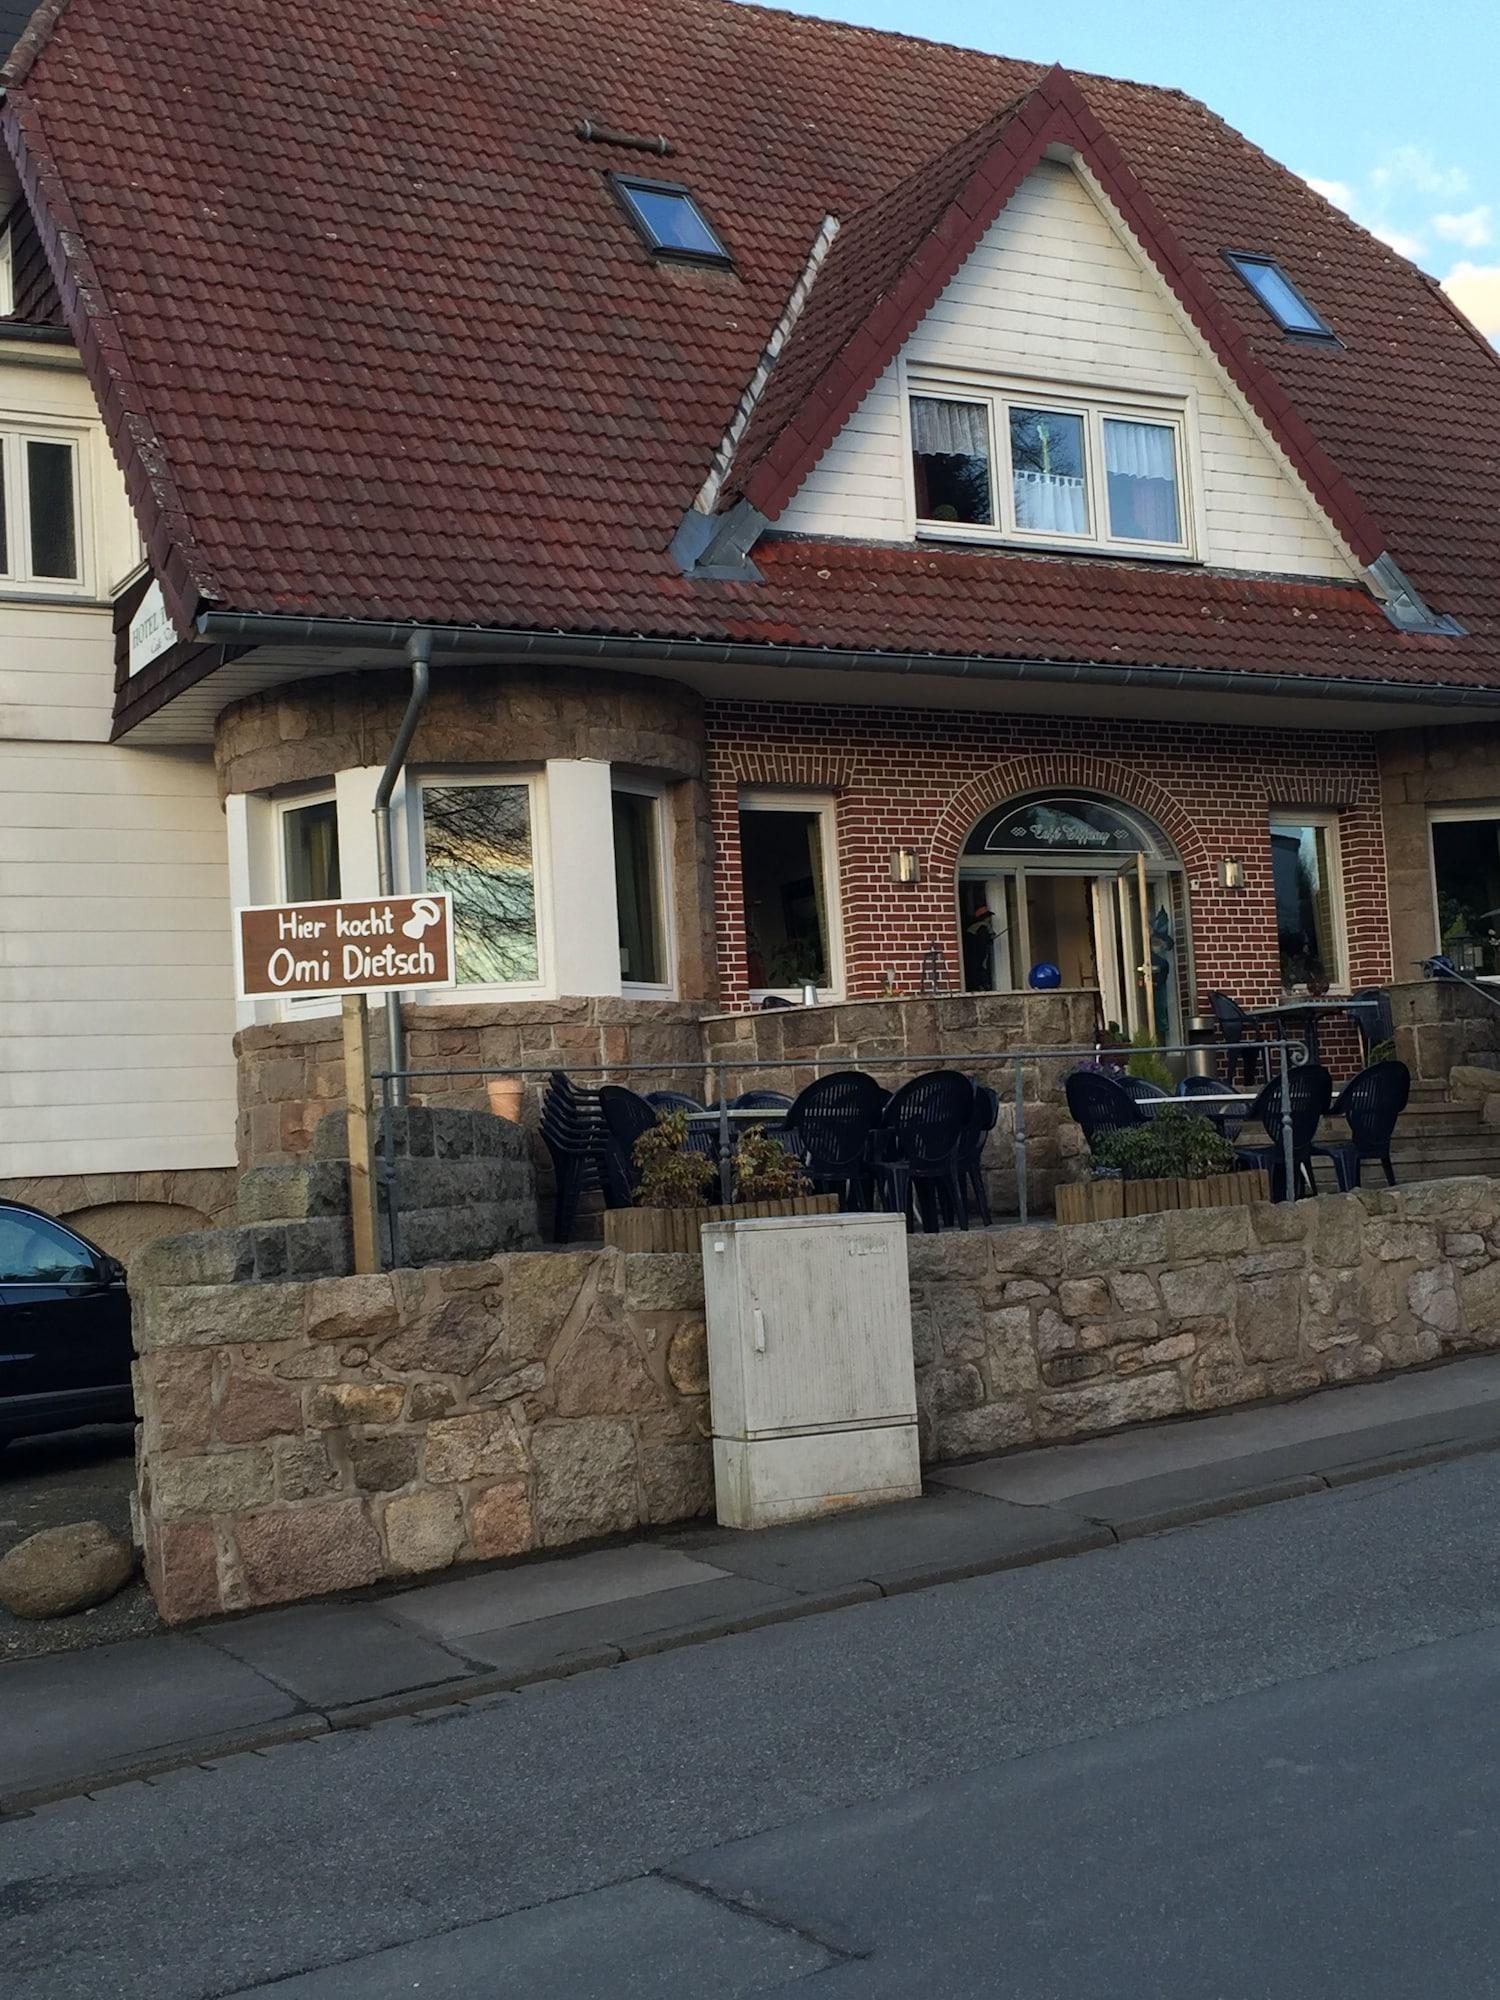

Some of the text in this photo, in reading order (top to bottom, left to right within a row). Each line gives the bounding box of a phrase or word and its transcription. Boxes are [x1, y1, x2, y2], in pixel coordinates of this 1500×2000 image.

[132, 612, 159, 650] HOTEL
[278, 906, 395, 940] Hier kocht
[268, 942, 435, 986] Omi Dietsch
